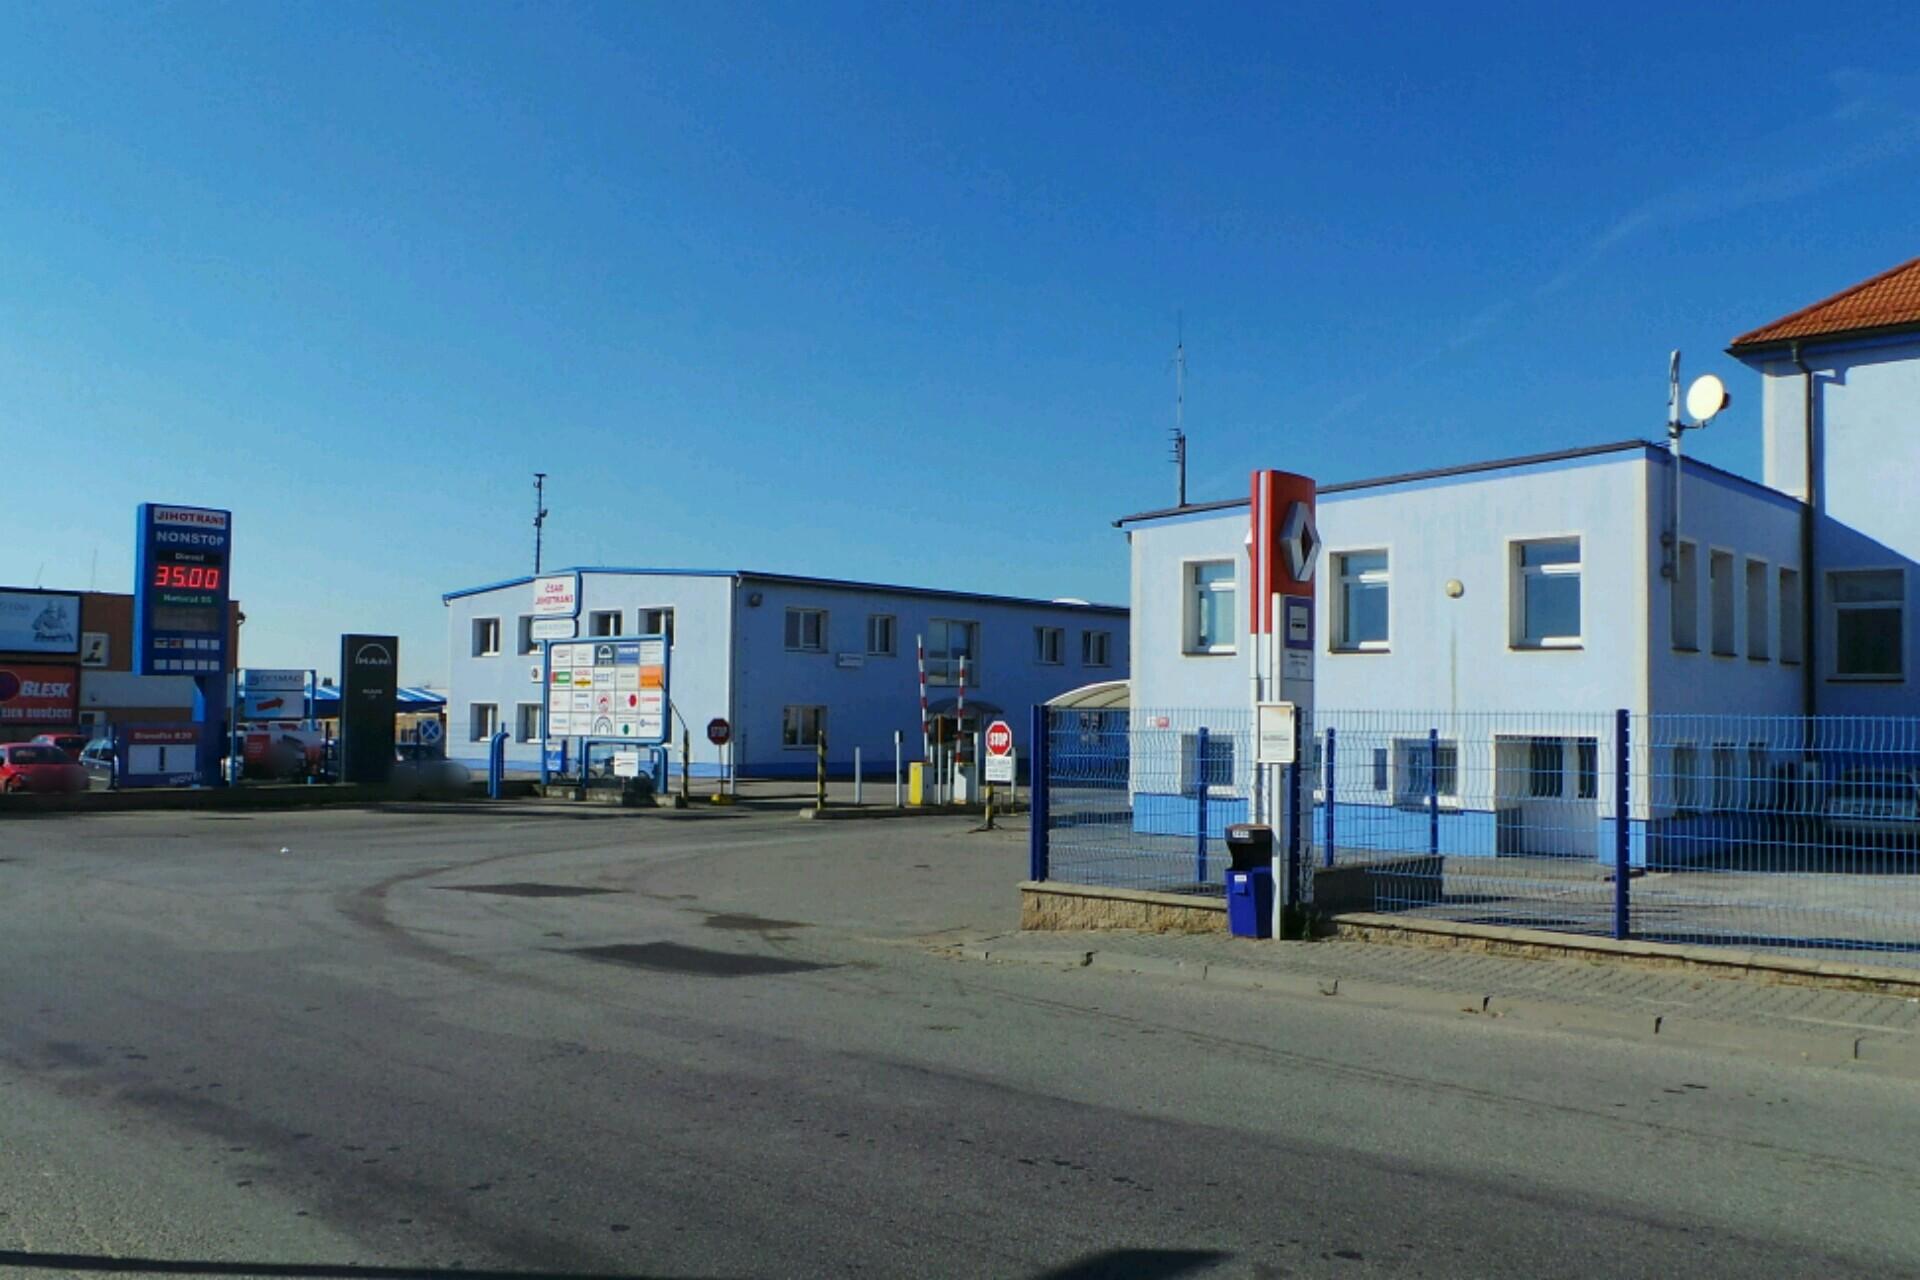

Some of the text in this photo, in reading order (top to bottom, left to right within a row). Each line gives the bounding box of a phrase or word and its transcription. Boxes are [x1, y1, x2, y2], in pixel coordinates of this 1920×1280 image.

[156, 531, 225, 546] NONSTOP
[358, 657, 389, 665] MAN
[20, 681, 71, 698] BLESK
[710, 726, 728, 737] STOP
[990, 732, 1008, 746] STOP
